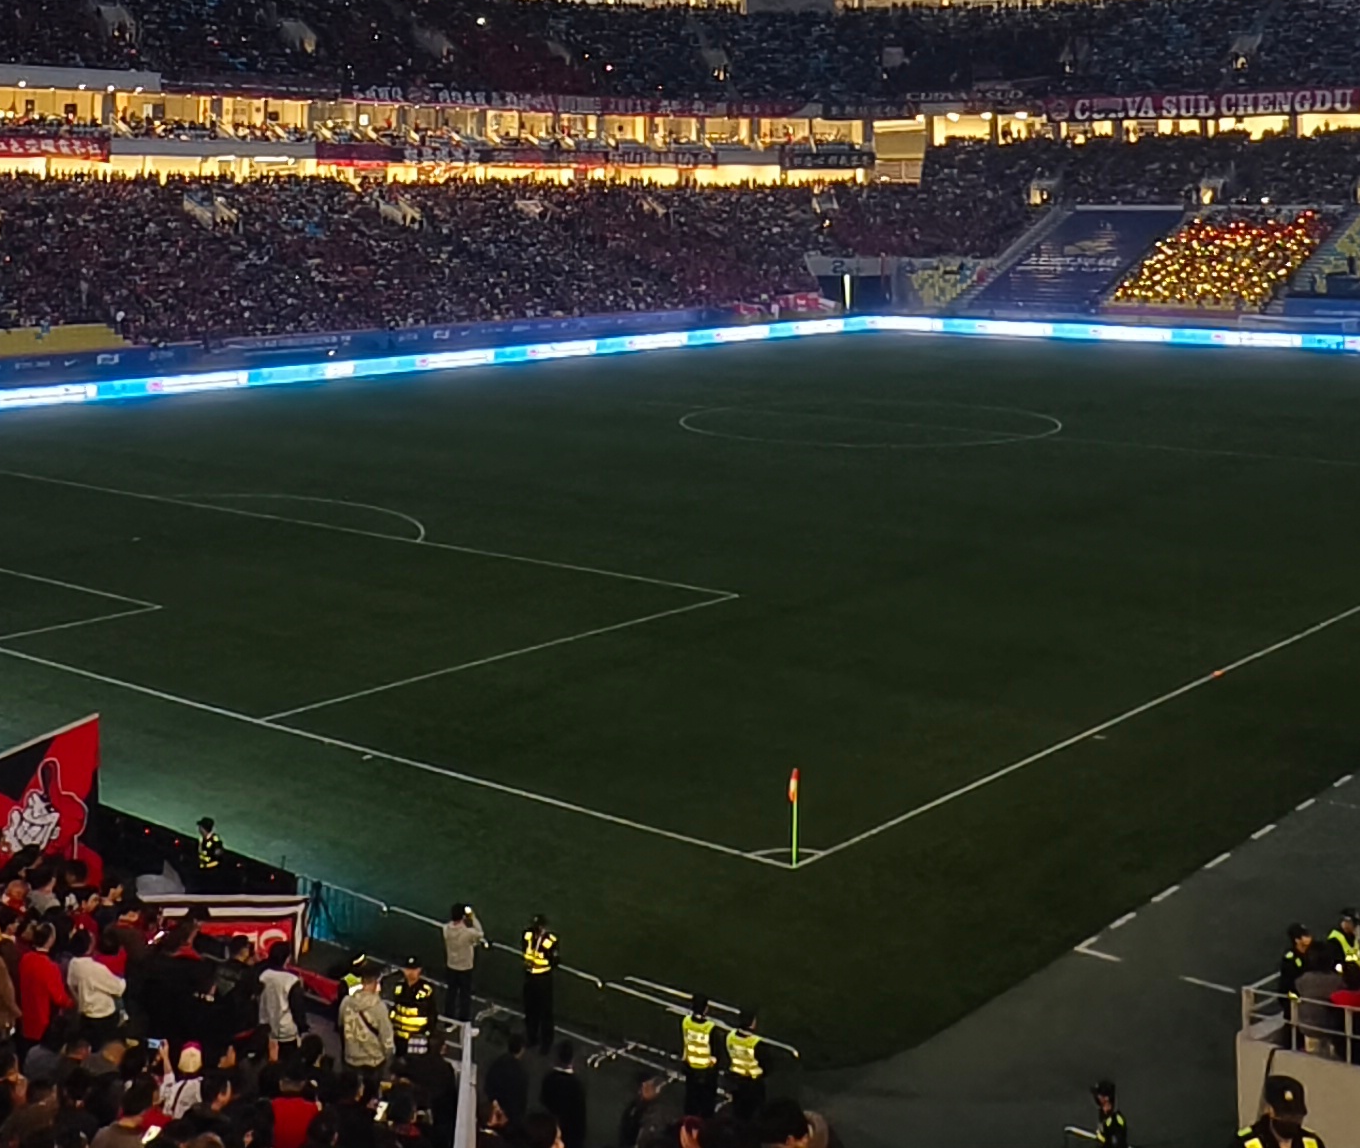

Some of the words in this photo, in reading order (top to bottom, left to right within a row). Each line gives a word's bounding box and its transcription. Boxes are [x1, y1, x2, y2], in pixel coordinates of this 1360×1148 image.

[1074, 95, 1156, 120] CVA
[1161, 92, 1217, 118] SUD
[1220, 89, 1354, 116] CHENGDU
